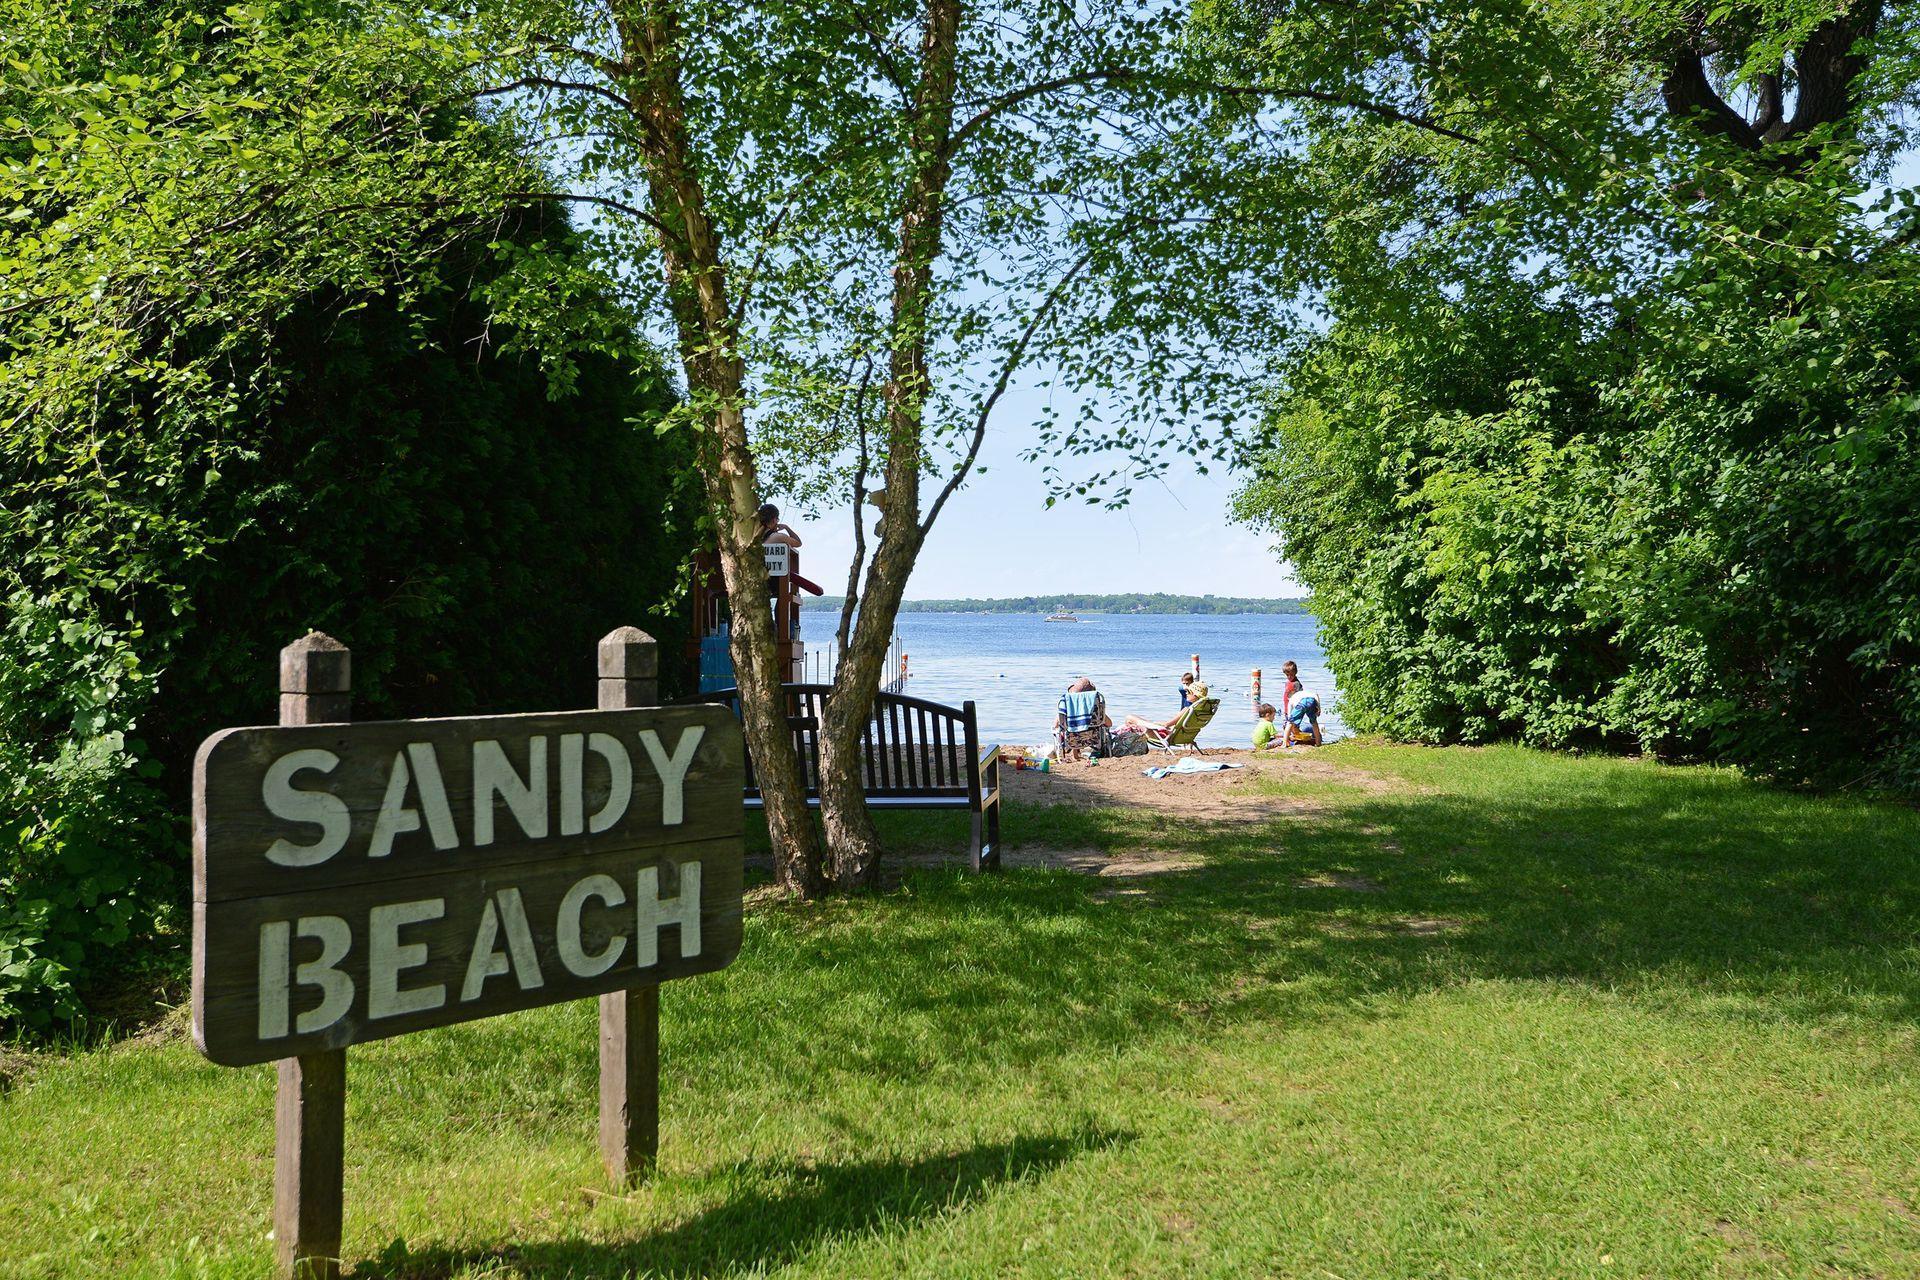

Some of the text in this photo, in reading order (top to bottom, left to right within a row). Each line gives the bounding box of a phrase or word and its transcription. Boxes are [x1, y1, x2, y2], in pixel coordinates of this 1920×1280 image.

[765, 546, 786, 556] UARD
[766, 562, 782, 570] UTY
[262, 725, 705, 867] SANDY
[258, 861, 702, 1040] BEACH
